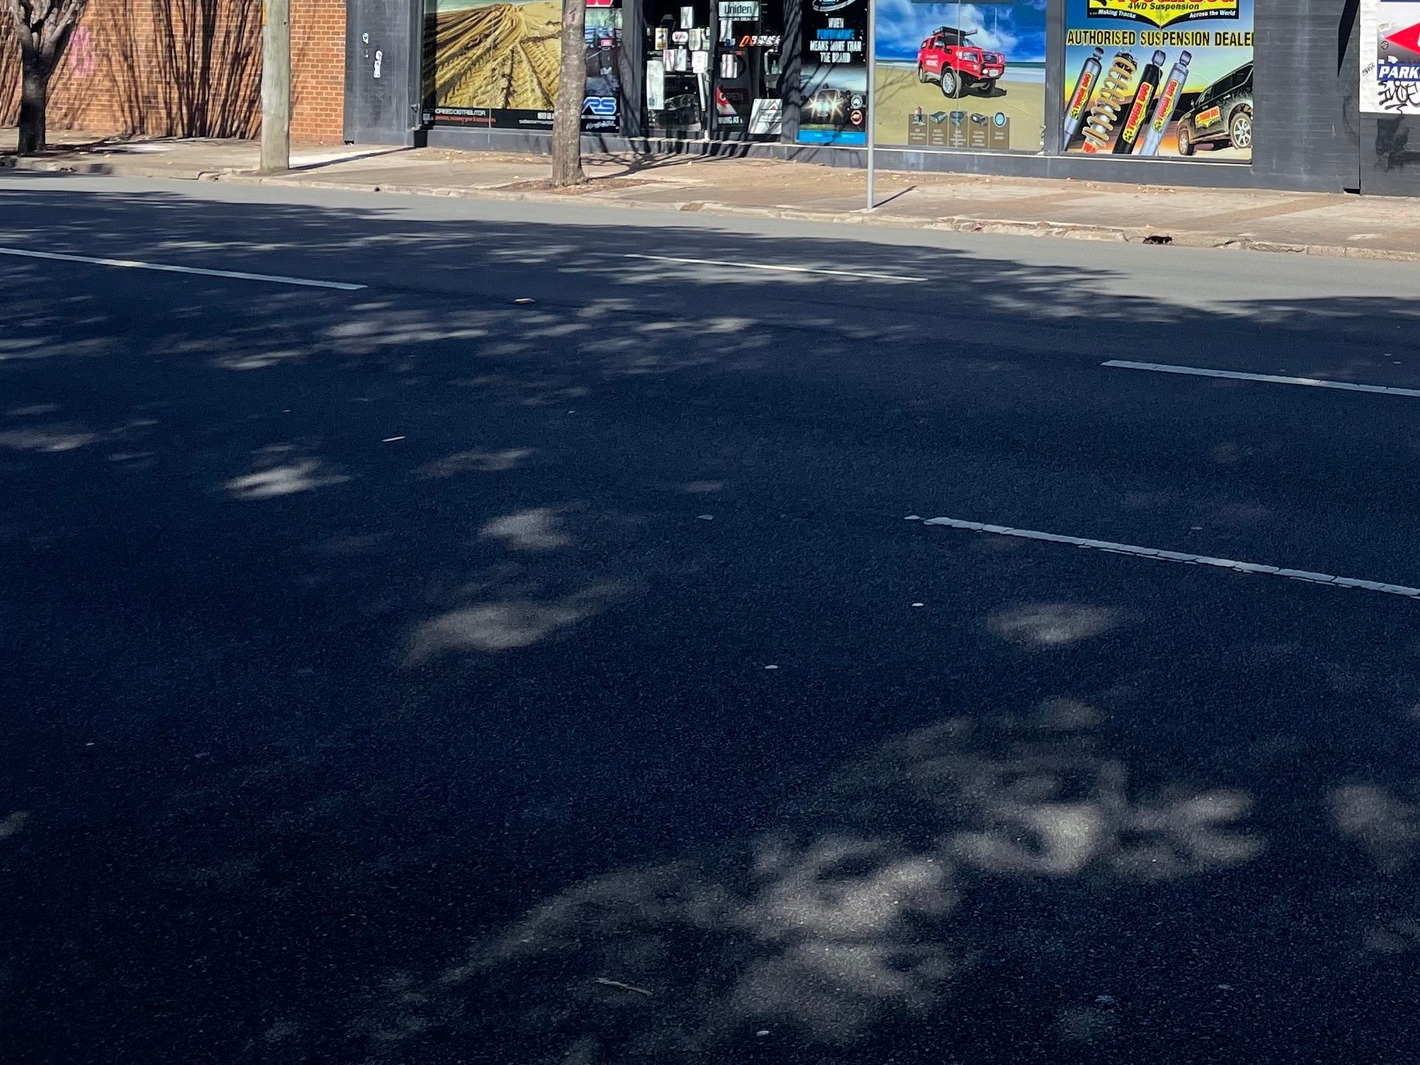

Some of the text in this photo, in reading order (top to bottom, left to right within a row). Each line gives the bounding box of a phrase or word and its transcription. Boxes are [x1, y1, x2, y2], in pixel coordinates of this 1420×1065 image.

[724, 3, 753, 15] Uniden
[1128, 1, 1200, 11] 4WD Suspension
[1098, 8, 1118, 18] Making
[1188, 9, 1236, 19] Across the World
[828, 17, 844, 29] WHEN
[1067, 30, 1136, 46] AUTHORISED
[1140, 30, 1210, 46] SUSPENSION
[809, 40, 862, 52] MEANS MORE THAN
[820, 52, 851, 63] THE BRAND
[1074, 88, 1087, 110] TOUGH
[1158, 80, 1179, 123] TOUGH DOG
[1125, 83, 1151, 132] TOUGH DOG
